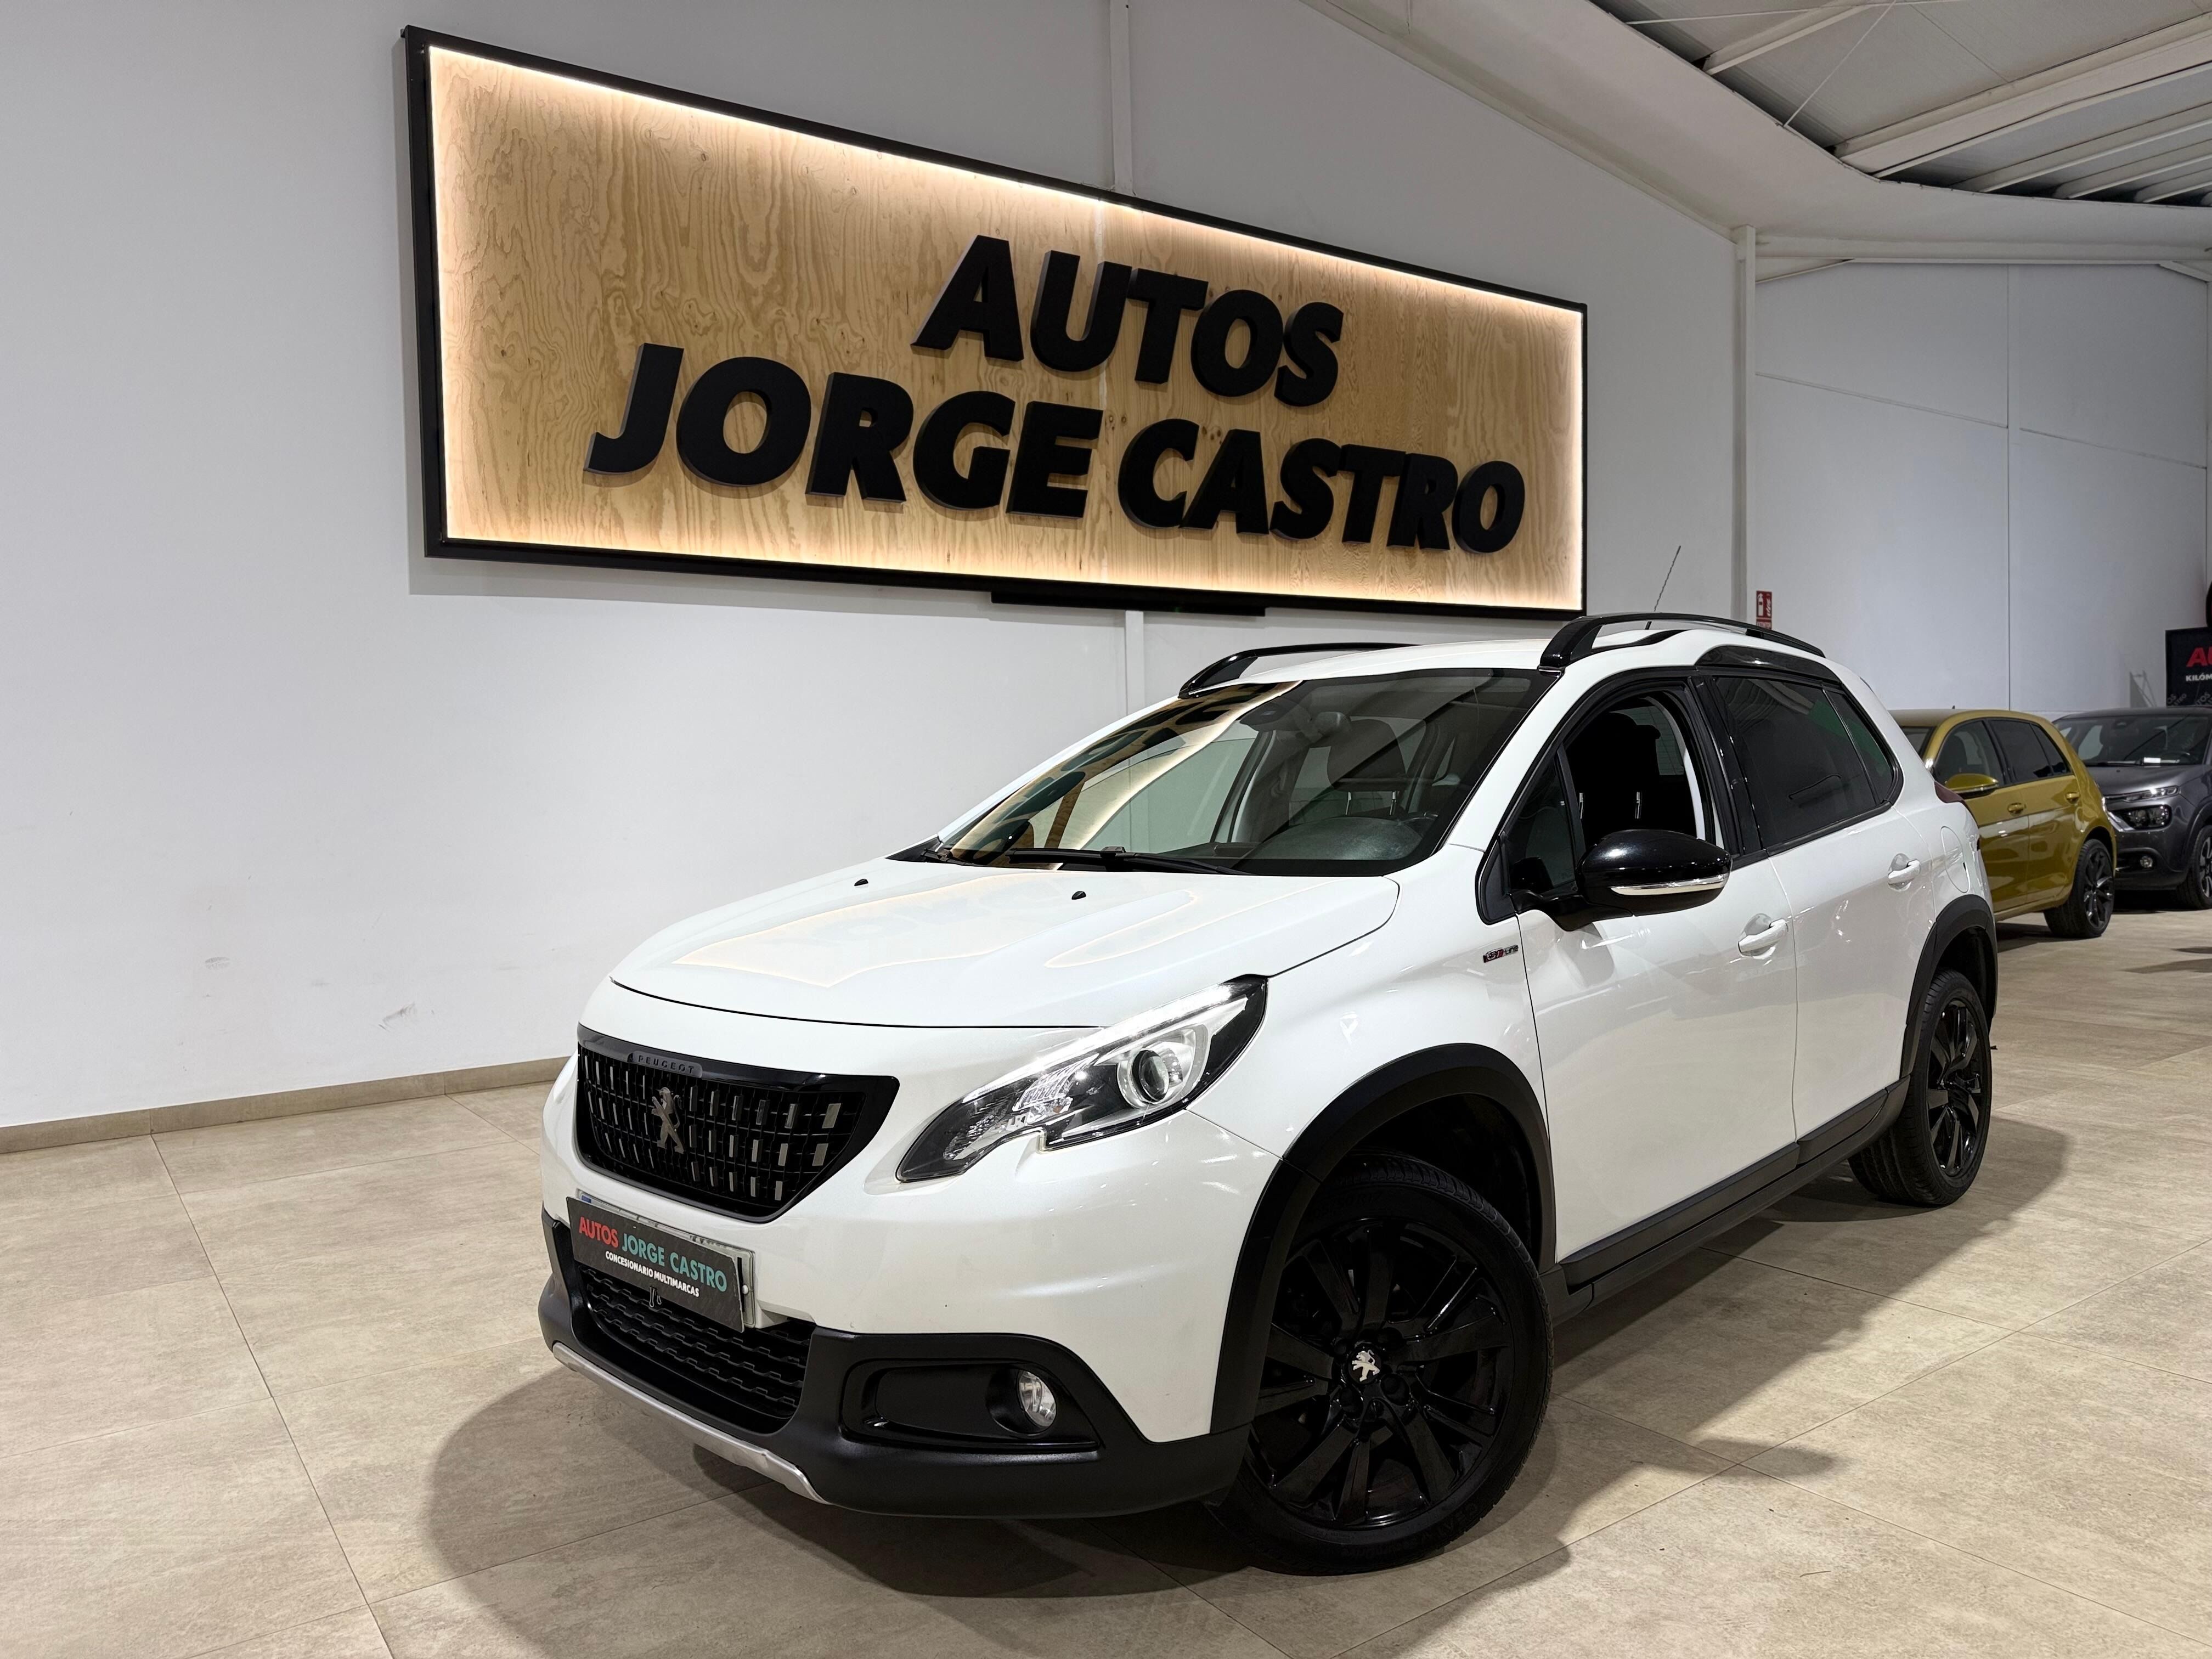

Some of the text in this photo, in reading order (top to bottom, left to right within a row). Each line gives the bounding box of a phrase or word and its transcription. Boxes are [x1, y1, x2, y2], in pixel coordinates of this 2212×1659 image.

[910, 234, 1344, 407] AUTOS
[583, 343, 1526, 554] JORGE CASTRO
[2186, 646, 2212, 667] A
[638, 1054, 695, 1074] PEUGEOT
[579, 1216, 618, 1248] AUTOS
[622, 1233, 665, 1267] JORGE
[670, 1252, 727, 1292] CASTRO
[605, 1251, 699, 1297] CONCESIONARIO MULTIMARCAS
